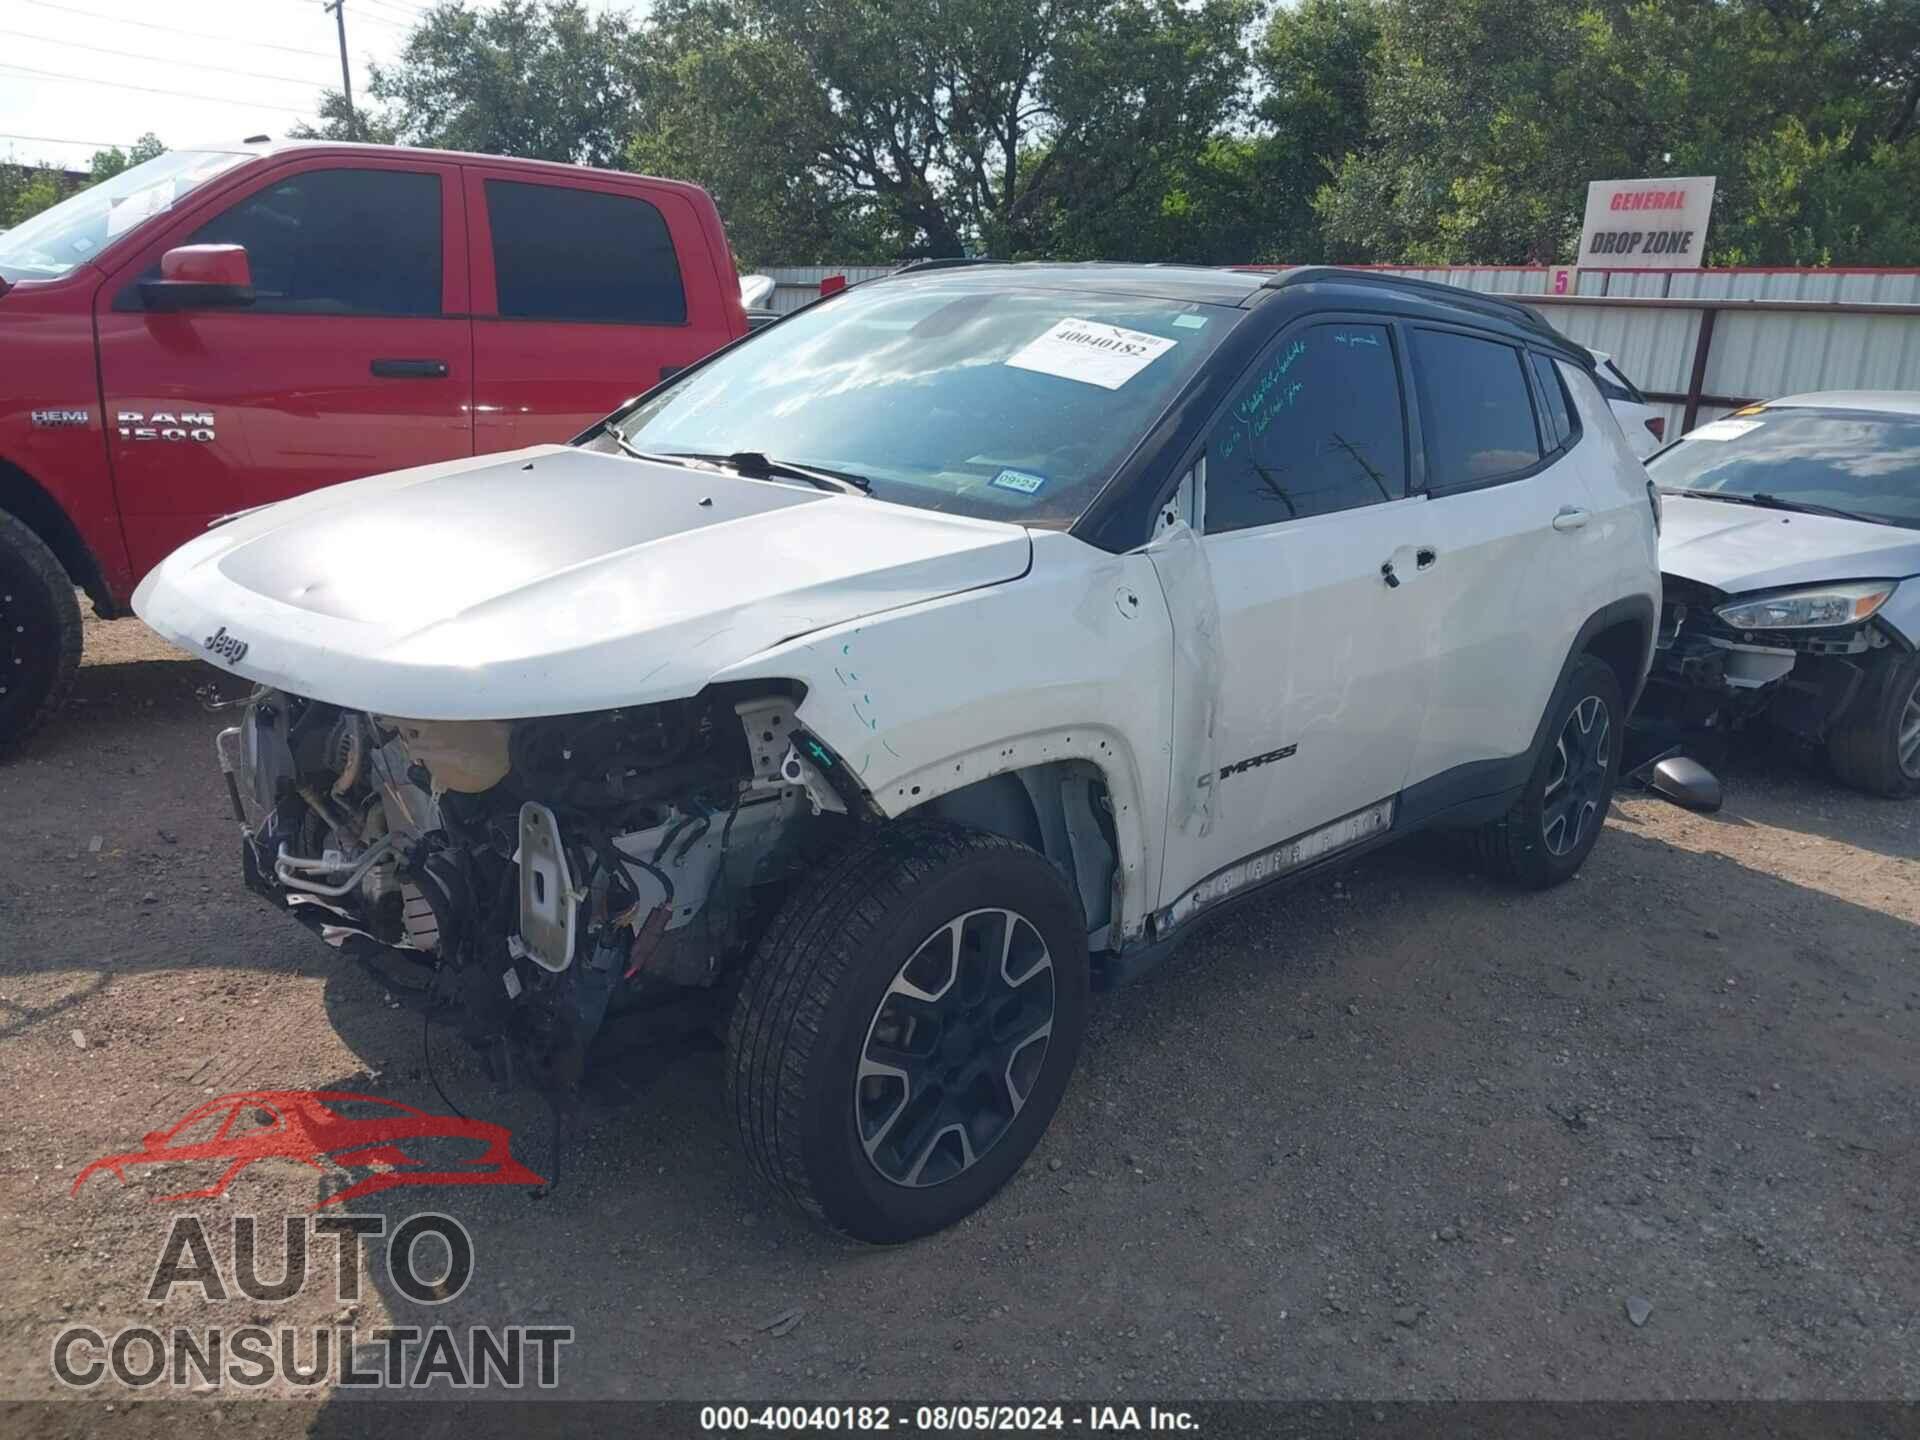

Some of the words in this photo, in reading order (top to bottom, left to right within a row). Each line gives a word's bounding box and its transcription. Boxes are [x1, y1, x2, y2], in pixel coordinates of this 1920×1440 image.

[1610, 191, 1686, 211] GENERAL
[1590, 232, 1642, 254] DROP
[1642, 231, 1694, 254] ZONE
[1555, 270, 1569, 295] 5
[1056, 329, 1147, 356] 40040182
[31, 410, 89, 421] HEMI
[117, 410, 215, 426] RAM
[118, 427, 215, 441] 1500
[204, 626, 249, 665] Jeep
